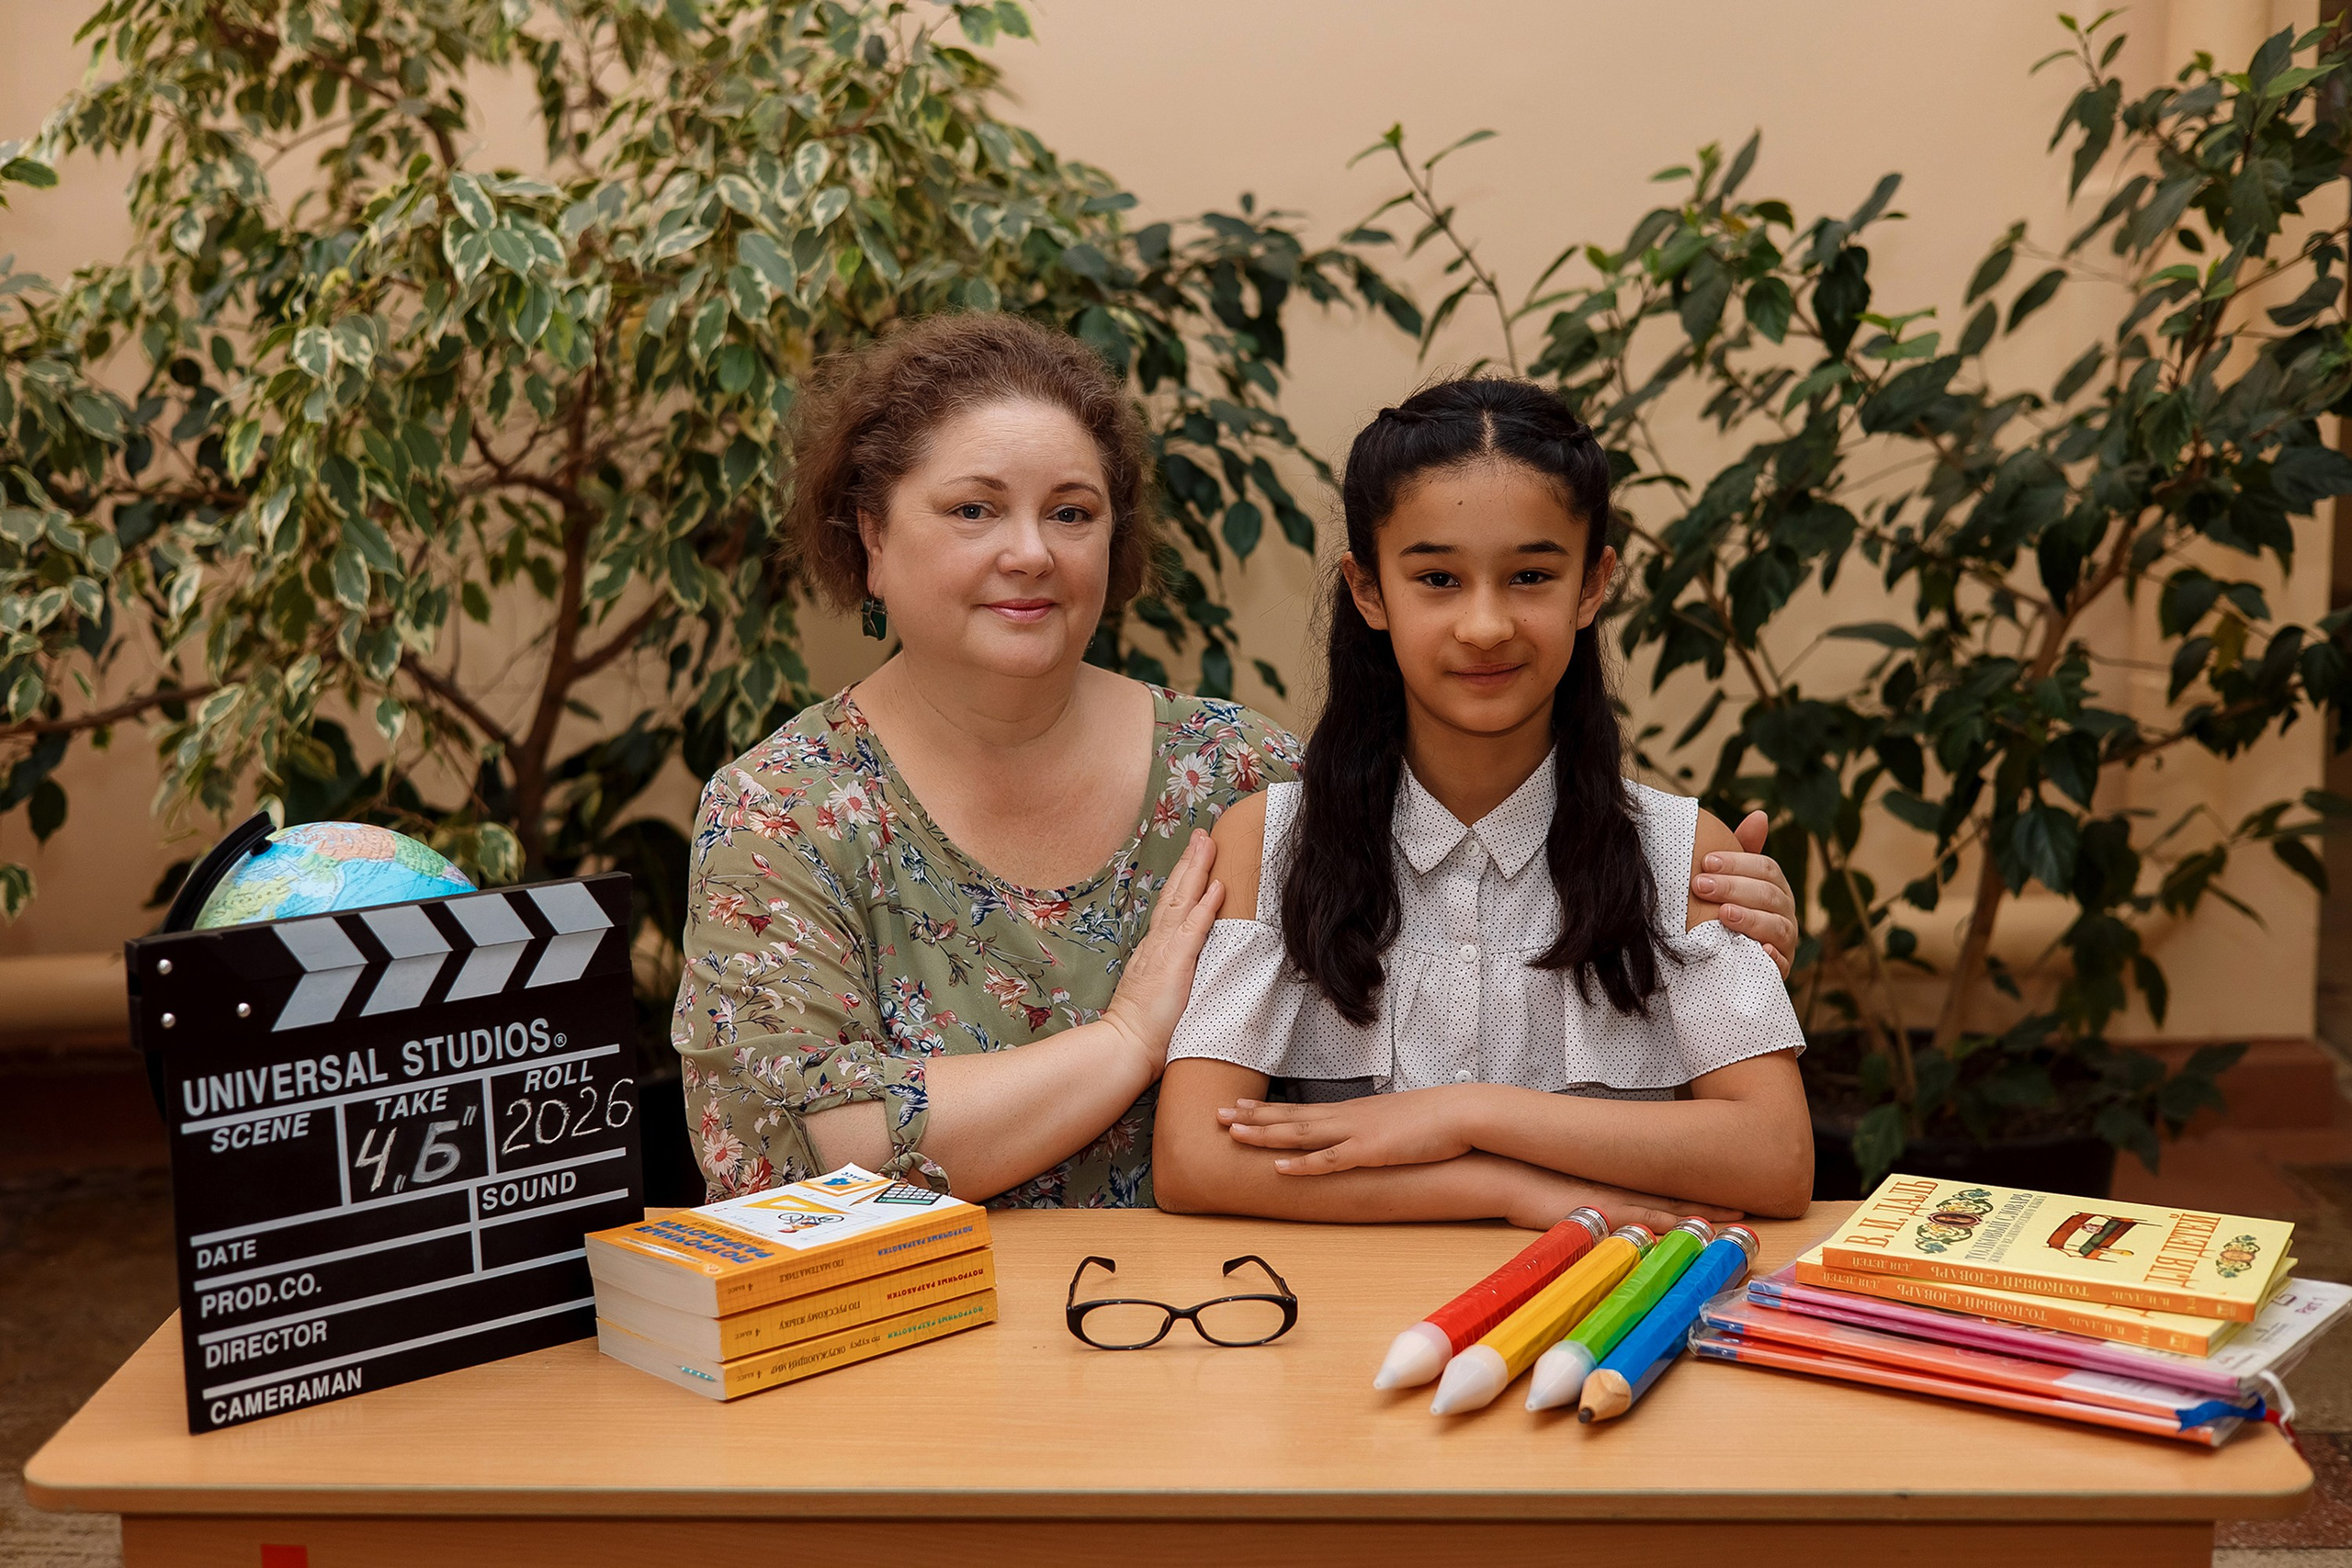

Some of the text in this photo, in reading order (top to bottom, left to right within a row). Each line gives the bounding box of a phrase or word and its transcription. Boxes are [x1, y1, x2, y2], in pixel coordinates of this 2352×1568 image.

[183, 1045, 388, 1117] UNIVERSAL
[523, 1060, 594, 1095] ROLL
[374, 1088, 448, 1122] TAKE
[501, 1077, 634, 1156] 2026
[210, 1112, 311, 1155] SCENE
[481, 1171, 577, 1212] SOUND
[1844, 1180, 1939, 1248] В. И. ДАЛЬ
[1964, 1193, 2033, 1259] ТОЛКОВЫЙ СЛОВАРЬ
[197, 1240, 257, 1269] DATE
[634, 1225, 754, 1264] ПОУРОЧНЫЕ
[654, 1220, 775, 1258] РАЗРАБОТКИ
[877, 1225, 973, 1257] ПОУРОЧНЫЕ РАЗРАБОТКИ
[2143, 1212, 2222, 1290] ДЛЯ ДЕТЕЙ
[779, 1258, 844, 1283] ПО МАТЕМАТИКЕ
[1823, 1272, 1881, 1290] ДЛЯ ДЕТЕЙ
[1852, 1257, 1913, 1274] ДЛЯ ДЕТЕЙ
[1931, 1265, 2089, 1297] ТОЛКОВЫЙ СЛОВАРЬ
[200, 1273, 322, 1318] PROD.CO.
[748, 1282, 753, 1292] 4
[887, 1268, 984, 1300] ПОУРОЧНЫЕ РАЗРАБОТКИ
[2111, 1292, 2146, 1304] ДАЛЬ
[779, 1301, 861, 1330] ПО РУССКОМУ ЯЗЫКУ
[1897, 1283, 2047, 1322] ТОЛКОВЫЙ СЛОВАРЬ
[755, 1328, 761, 1337] 4
[888, 1306, 983, 1338] ПОУРОЧНЫЕ РАЗРАБОТКИ
[2069, 1316, 2102, 1330] ДАЛЬ
[205, 1321, 328, 1370] DIRECTOR
[771, 1336, 881, 1375] по курсу ОКРУЖАЮЩИЙ МИР
[757, 1370, 763, 1379] 4
[209, 1369, 363, 1426] CAMERAMAN
